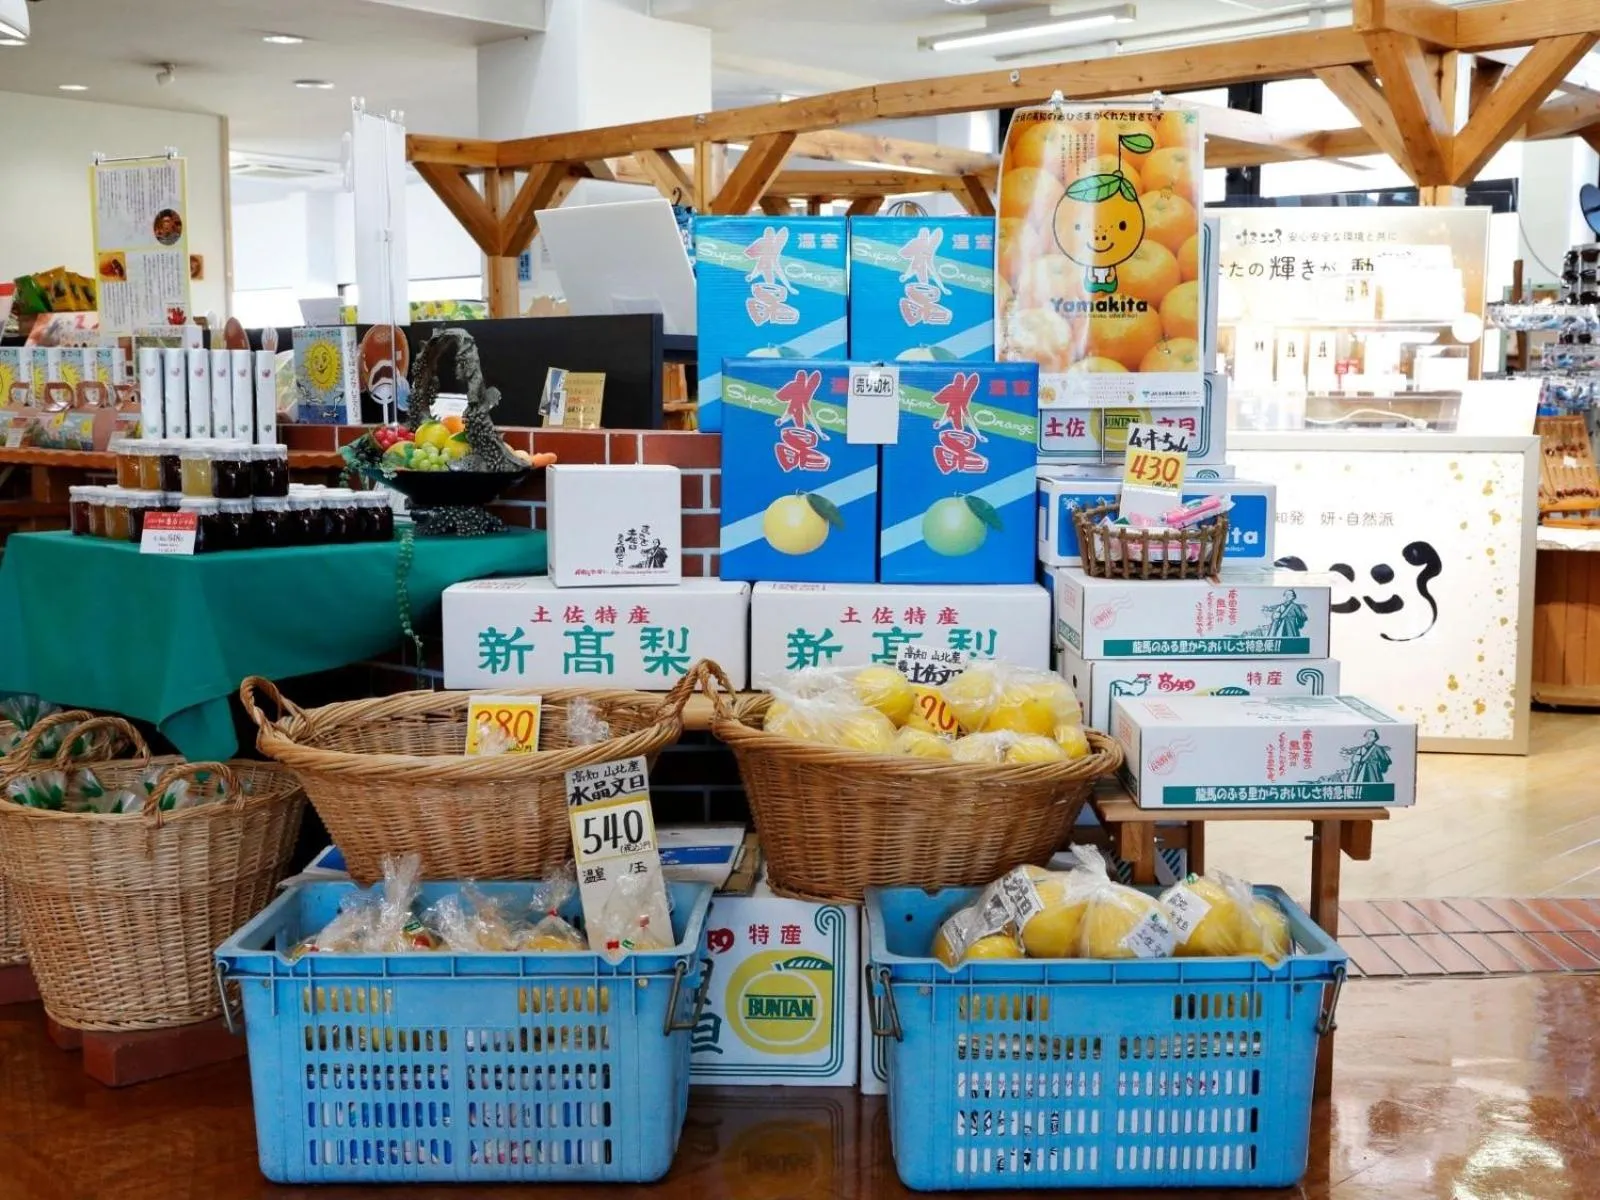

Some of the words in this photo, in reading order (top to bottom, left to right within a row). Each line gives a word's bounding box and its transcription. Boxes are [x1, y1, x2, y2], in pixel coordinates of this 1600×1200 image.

[1050, 296, 1148, 312] Yamakita
[973, 409, 1035, 436] Orange
[1045, 417, 1085, 437] 土佐
[1130, 454, 1180, 481] 430
[530, 605, 651, 624] 土佐特産
[839, 606, 960, 625] 土佐特産
[1246, 670, 1283, 686] 特産
[568, 774, 648, 807] 水晶文旦
[582, 809, 644, 855] 540
[748, 923, 802, 945] 特産
[748, 997, 814, 1018] BUNTAN
